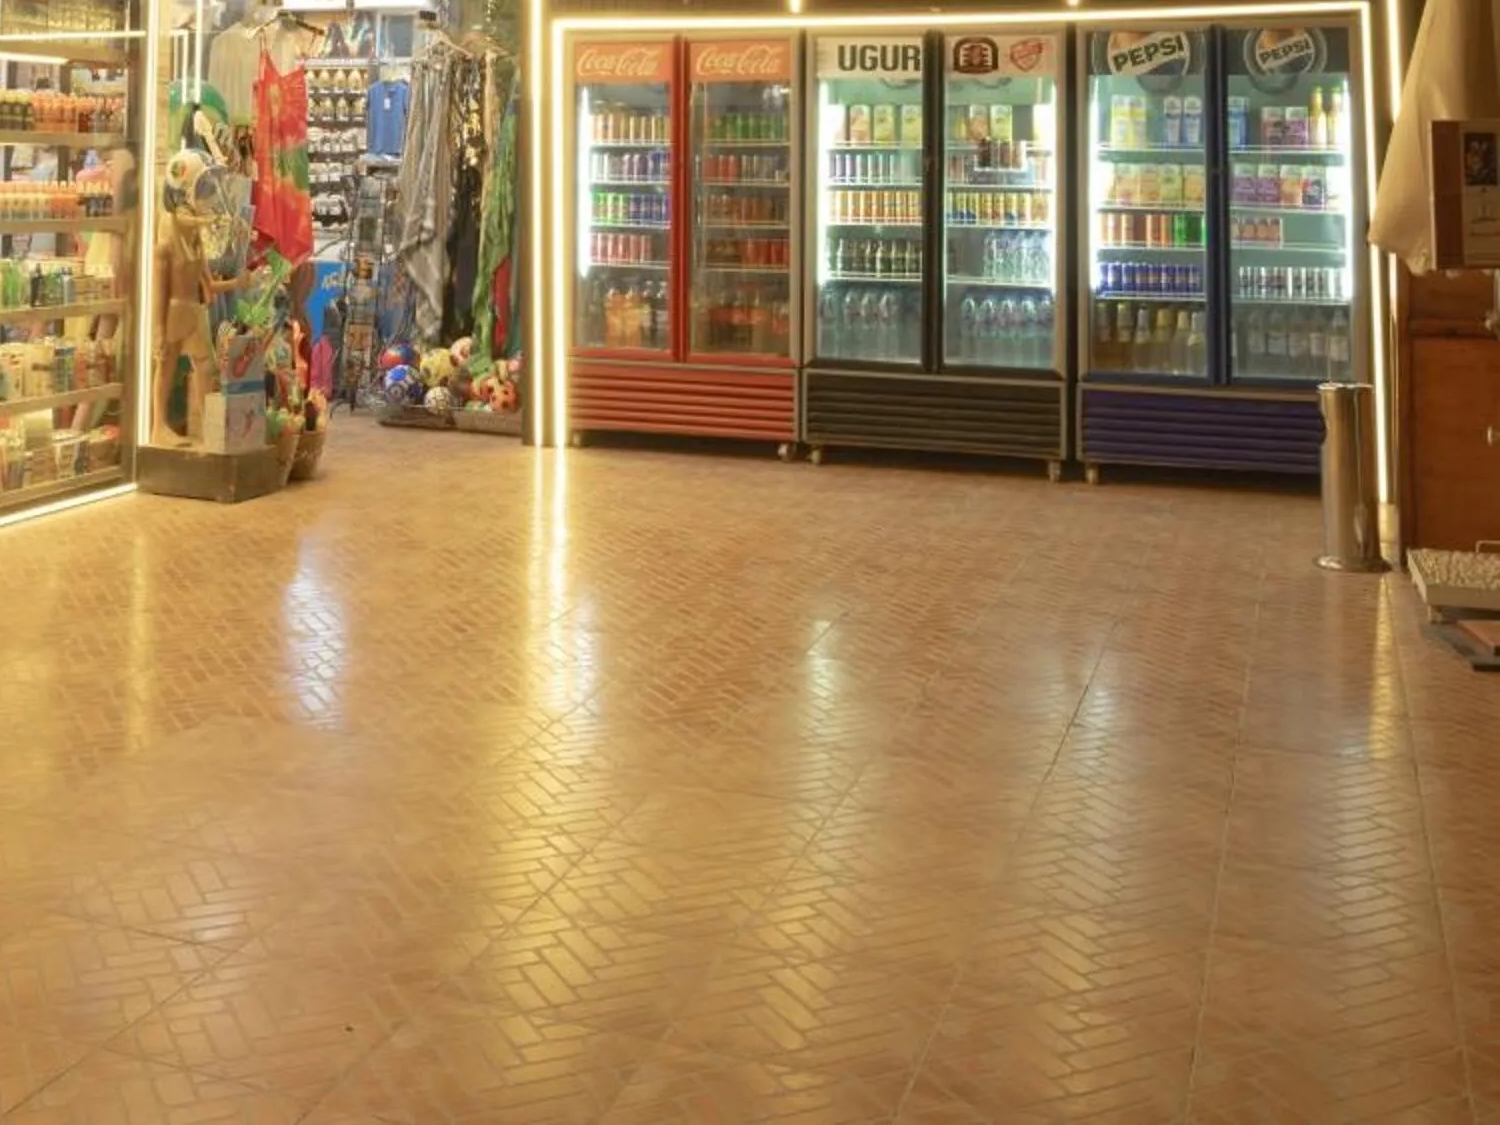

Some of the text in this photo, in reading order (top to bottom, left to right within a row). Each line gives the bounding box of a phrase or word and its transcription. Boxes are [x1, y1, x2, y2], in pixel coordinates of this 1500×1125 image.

[576, 44, 662, 77] Coca-Cola
[695, 43, 784, 76] Coca-Cola
[837, 44, 921, 72] UGUR
[1111, 34, 1185, 72] PEPSI
[1258, 37, 1312, 65] PEPSI
